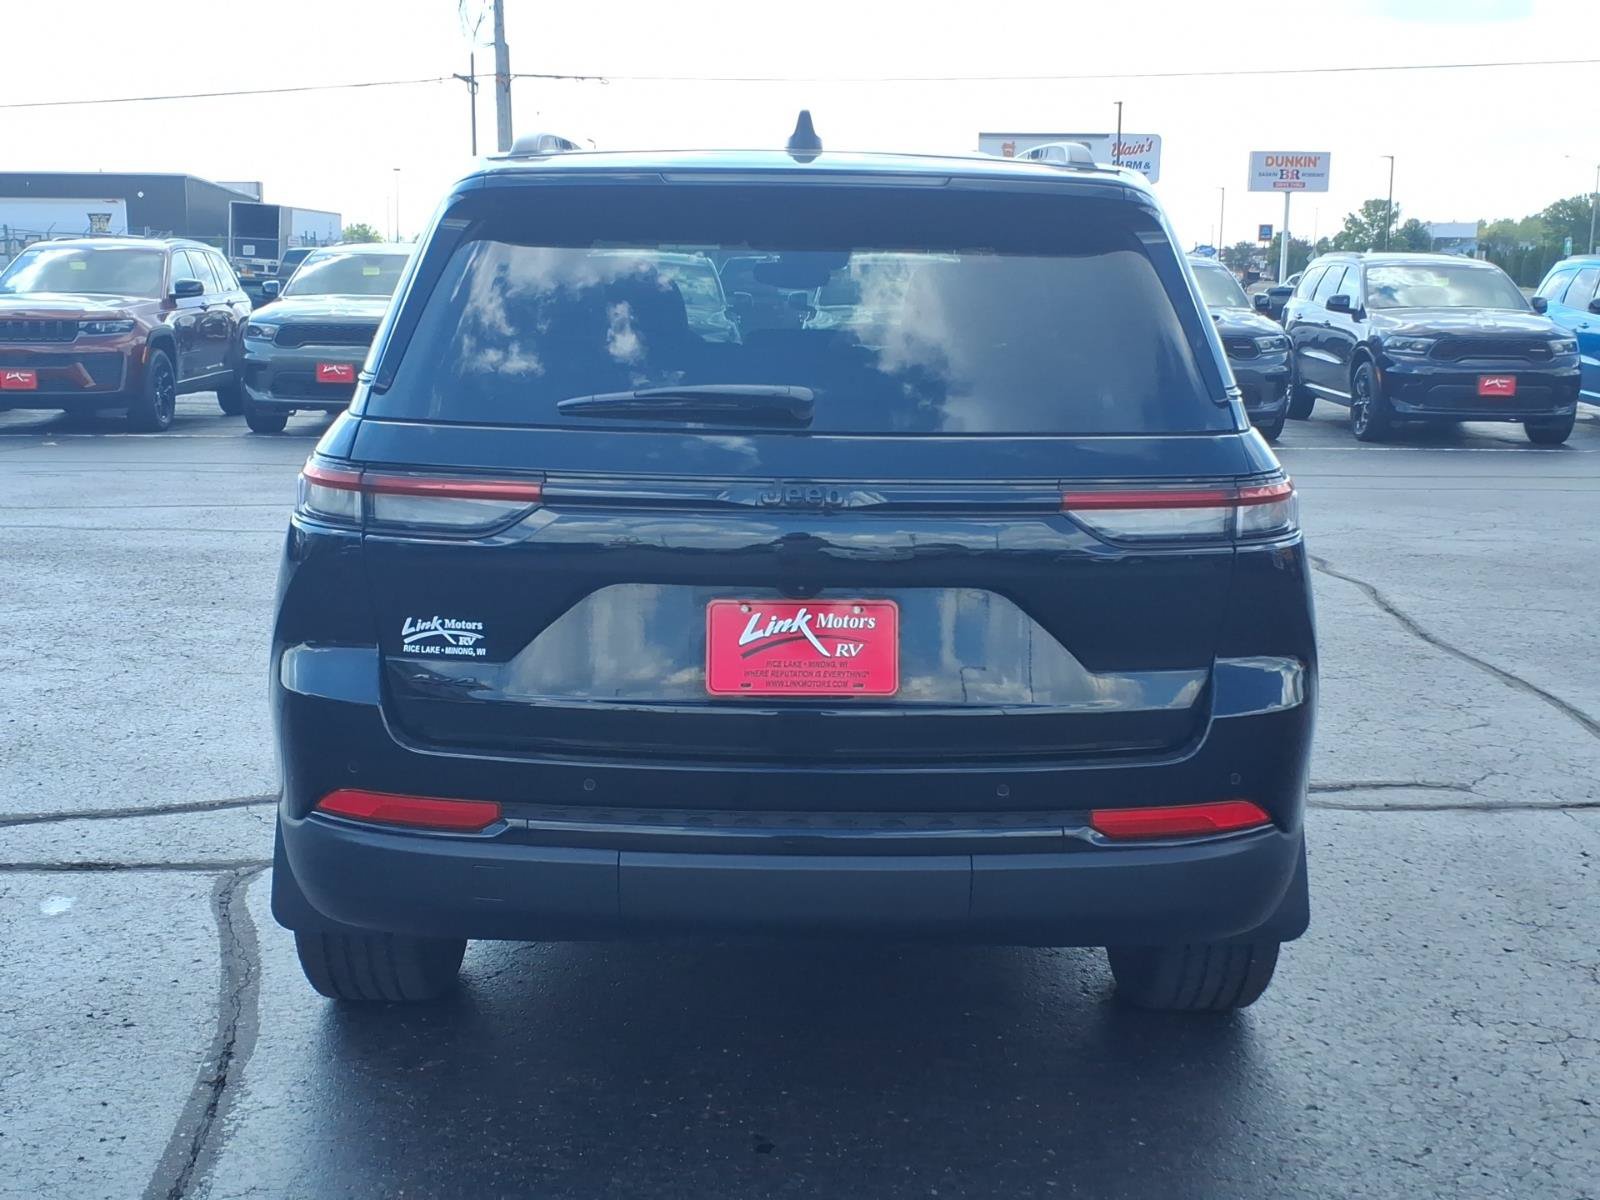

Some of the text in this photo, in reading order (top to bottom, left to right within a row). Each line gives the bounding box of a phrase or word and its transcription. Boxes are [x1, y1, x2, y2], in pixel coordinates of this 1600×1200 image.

[1265, 155, 1321, 168] DUNKIN'
[1279, 168, 1300, 180] BR
[760, 479, 845, 513] Jeep
[401, 615, 483, 645] Link Motors
[738, 607, 876, 658] Link Motors
[458, 636, 477, 646] RV
[403, 644, 420, 653] RICE
[421, 645, 440, 654] LAKE
[476, 648, 486, 656] WI
[834, 643, 864, 657] RV
